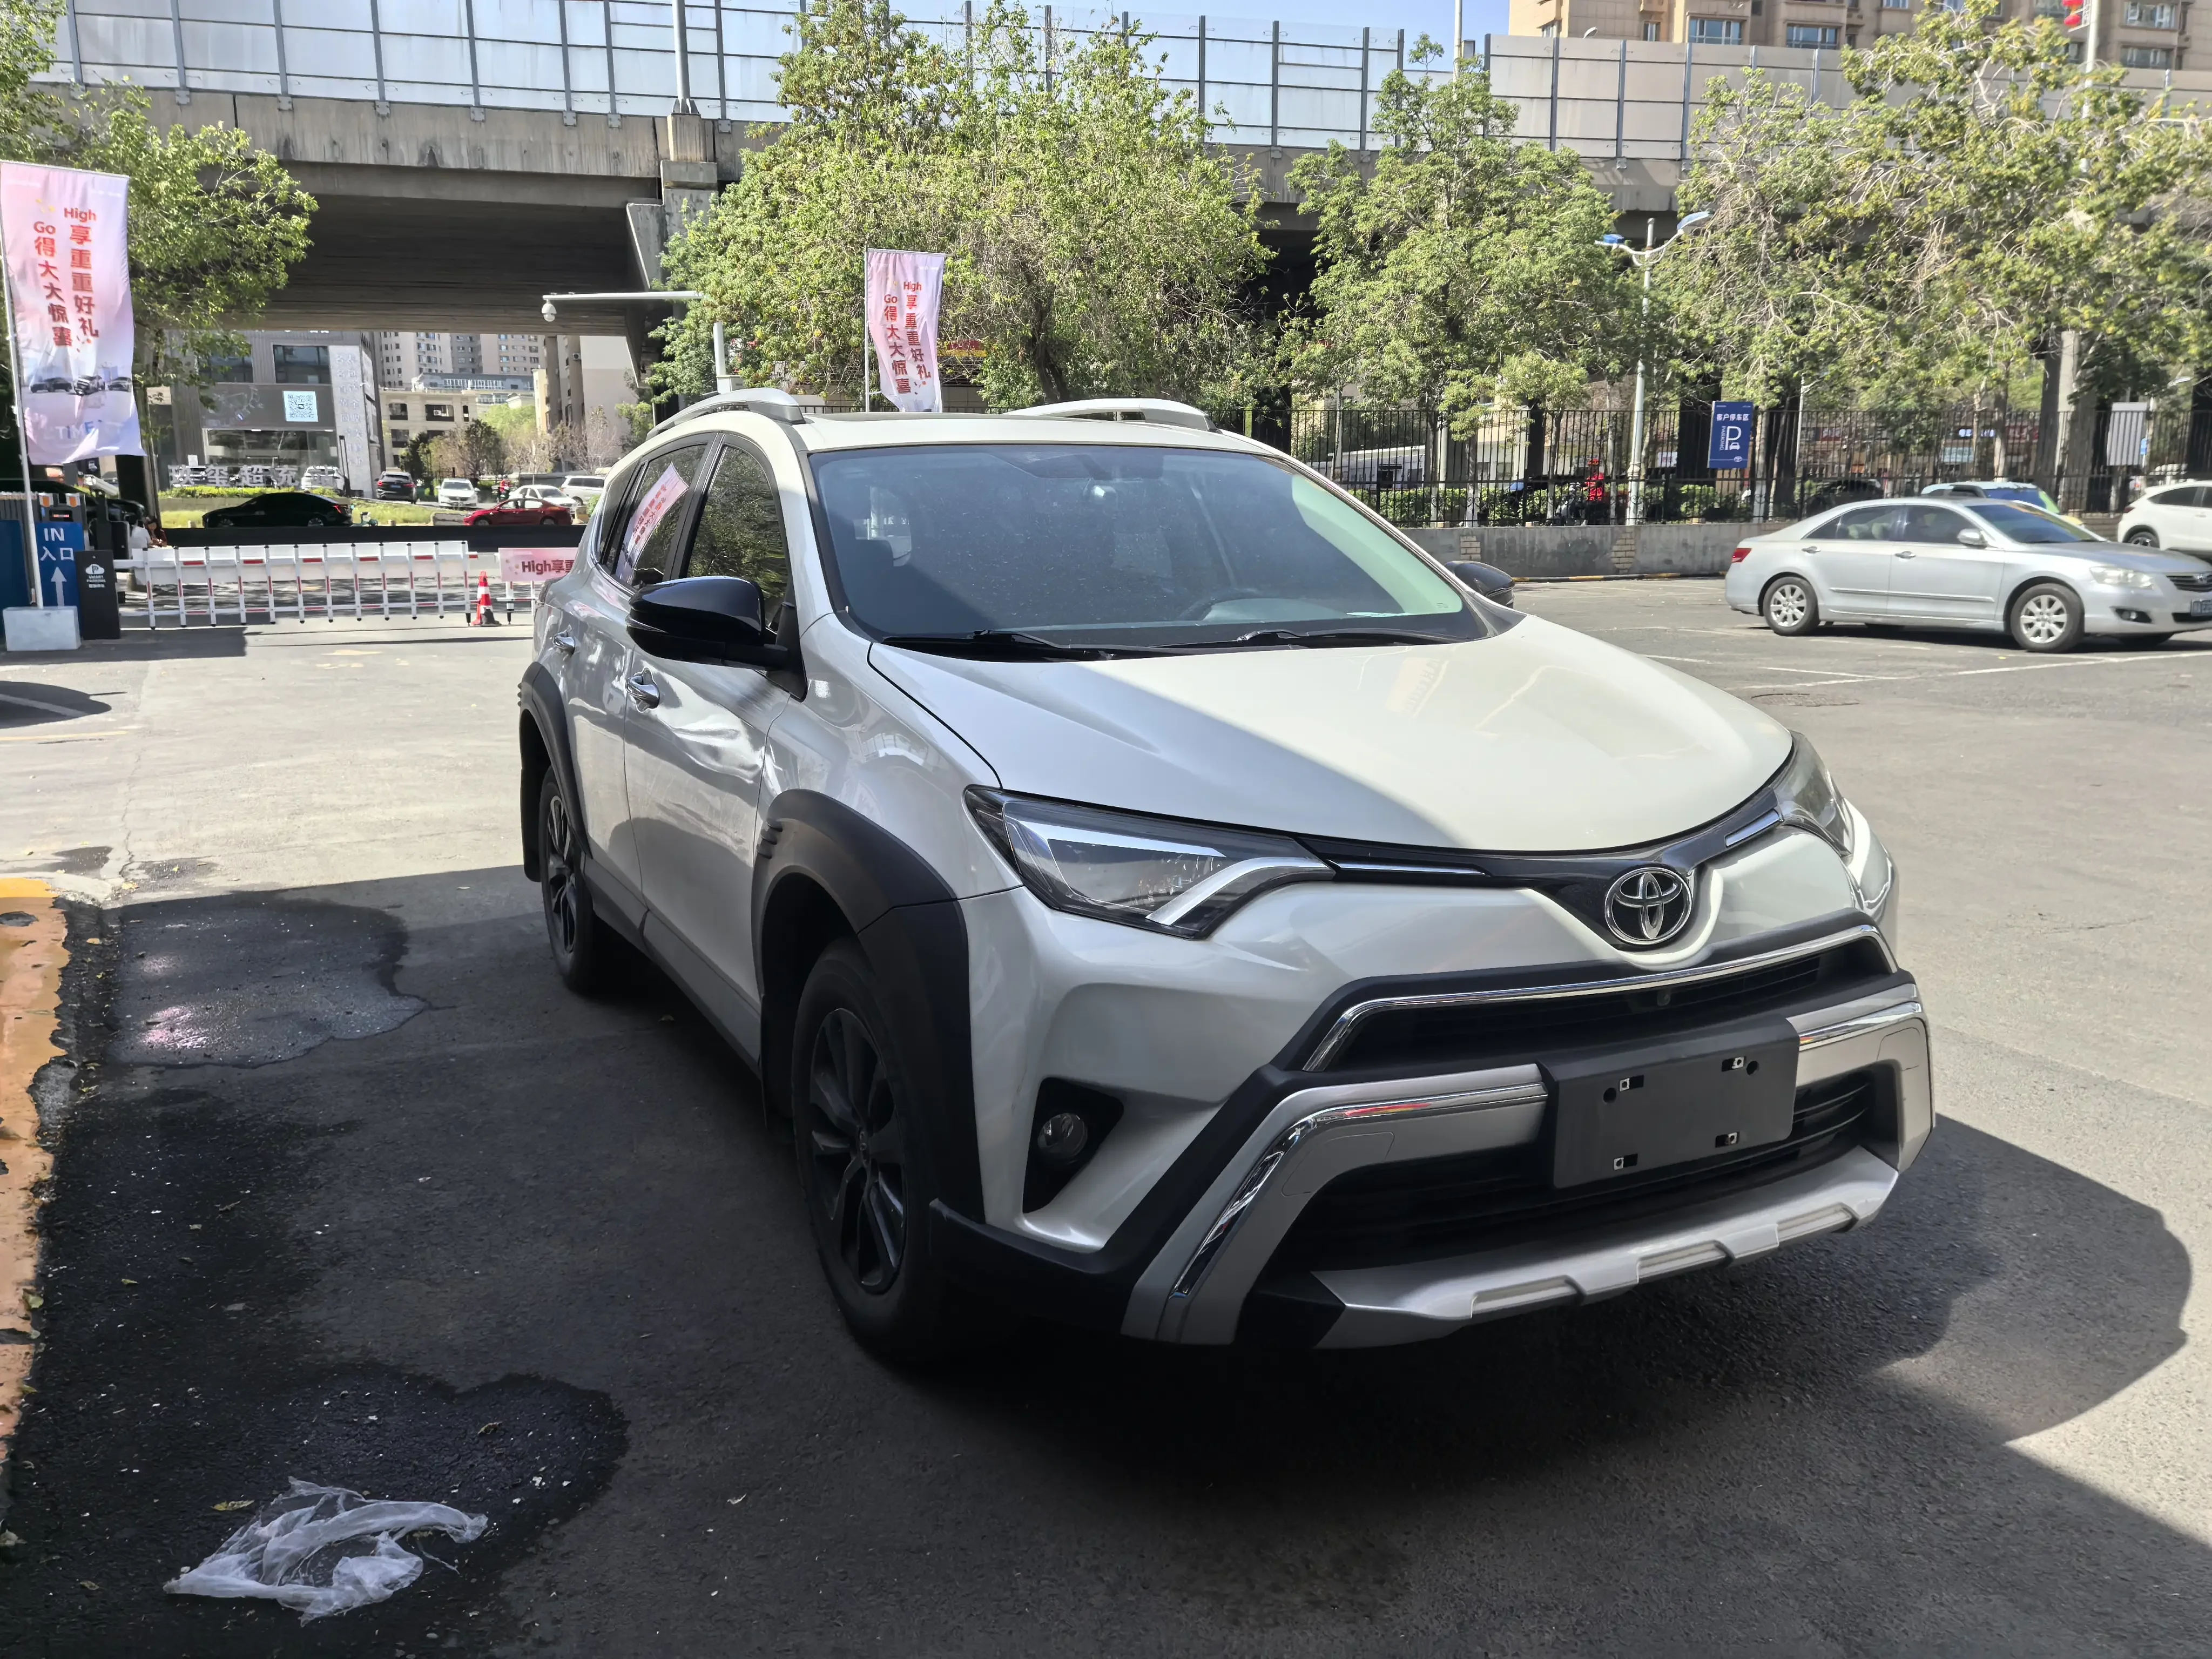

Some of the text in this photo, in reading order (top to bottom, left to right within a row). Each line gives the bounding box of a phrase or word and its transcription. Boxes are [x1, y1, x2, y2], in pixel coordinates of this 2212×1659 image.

[64, 207, 97, 223] High
[33, 221, 56, 234] Go
[903, 281, 922, 292] High
[884, 294, 898, 304] Go
[1725, 426, 1742, 450] P
[44, 527, 65, 542] IN
[40, 546, 75, 561] 入口
